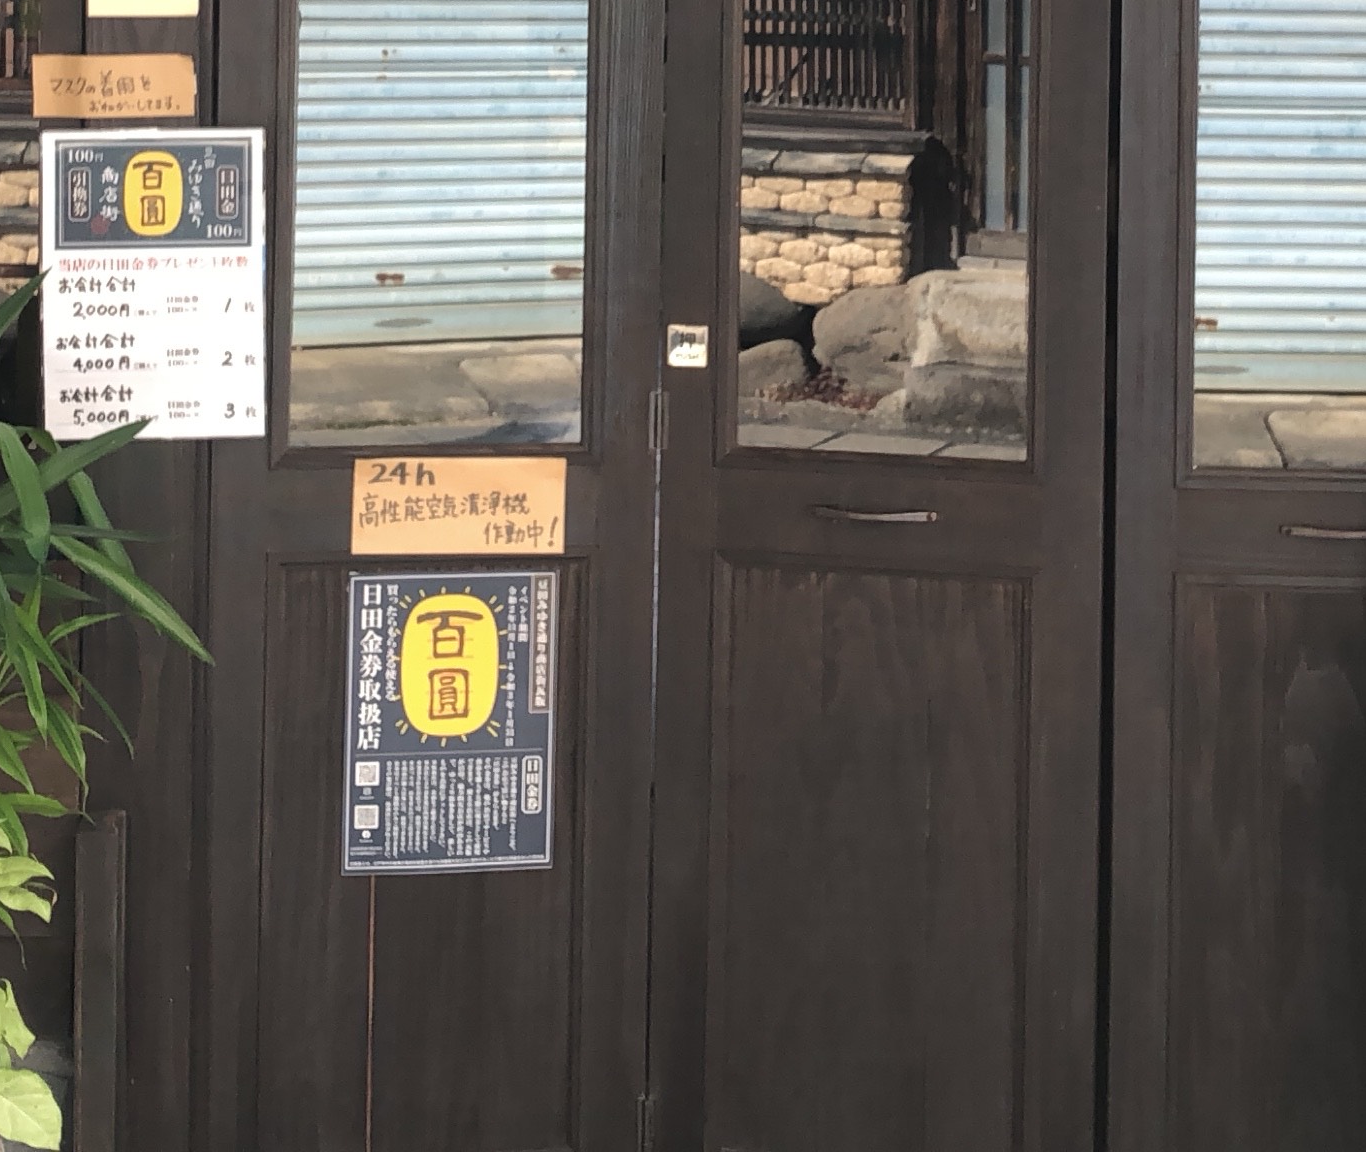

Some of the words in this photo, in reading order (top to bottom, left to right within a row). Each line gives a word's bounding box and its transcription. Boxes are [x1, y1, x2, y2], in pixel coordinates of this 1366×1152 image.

[50, 69, 152, 97] マスクの着用を
[99, 165, 121, 222] 商店街
[188, 159, 204, 228] みゆき通り
[58, 276, 136, 294] お会計合計
[72, 302, 130, 320] 2,000円
[56, 332, 135, 351] お会計合計
[72, 356, 130, 373] 4,000円
[222, 351, 233, 366] 2
[60, 384, 133, 403] お会計合計
[72, 409, 130, 426] 5,000円
[224, 403, 235, 419] 3
[367, 461, 436, 487] 24h
[359, 490, 531, 528] 高性能空気清浄機
[356, 583, 383, 751] 日田金券取扱店
